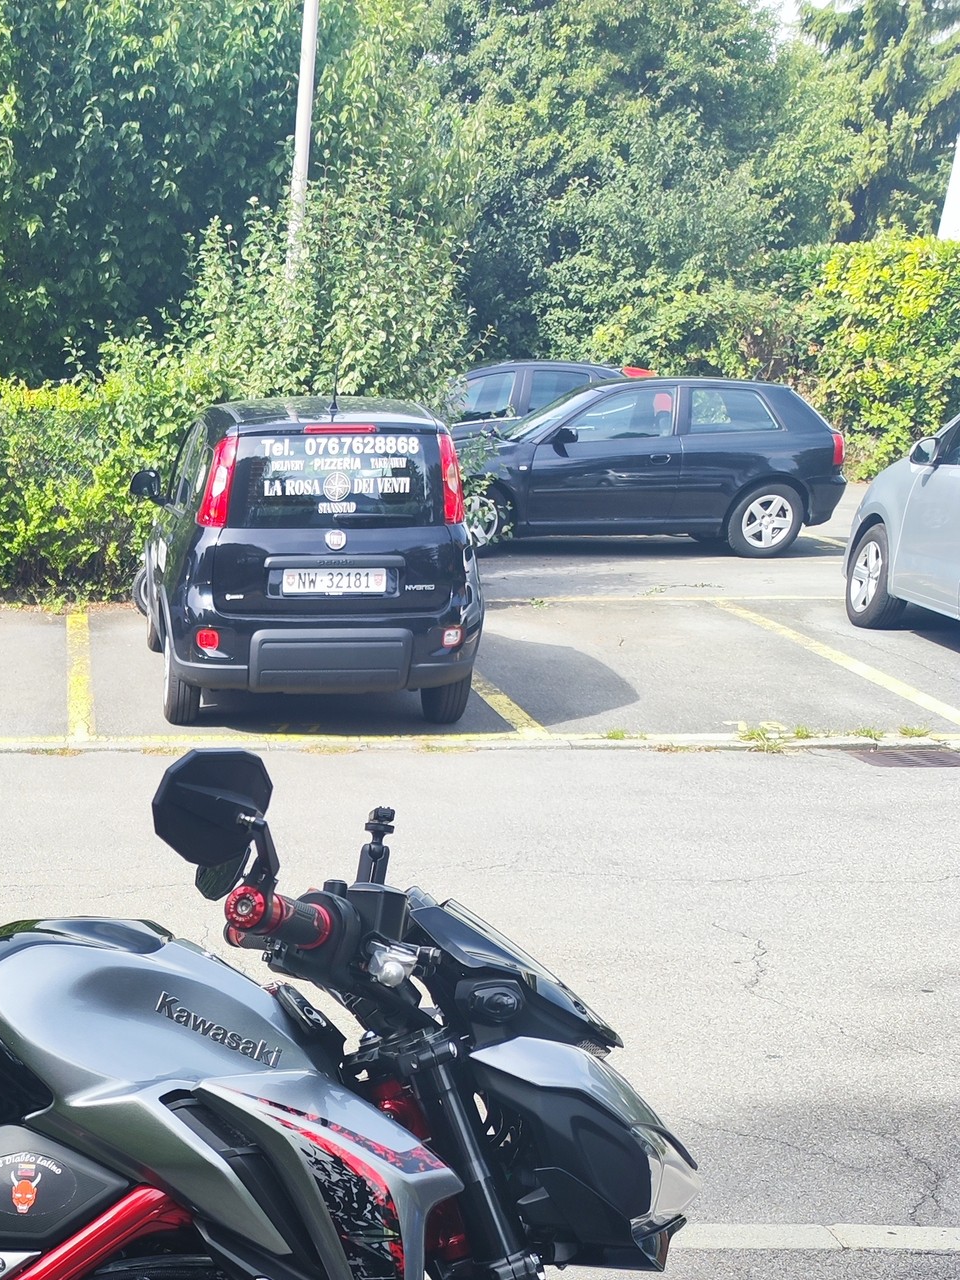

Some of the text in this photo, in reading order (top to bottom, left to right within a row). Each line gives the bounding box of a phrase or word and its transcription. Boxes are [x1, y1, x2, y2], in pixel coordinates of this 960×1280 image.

[261, 437, 419, 456] Tel. 0767628868
[313, 458, 361, 471] PIZZERIA
[263, 477, 410, 497] LA ROSA DEI VENTI
[155, 990, 283, 1069] Kawasaki
